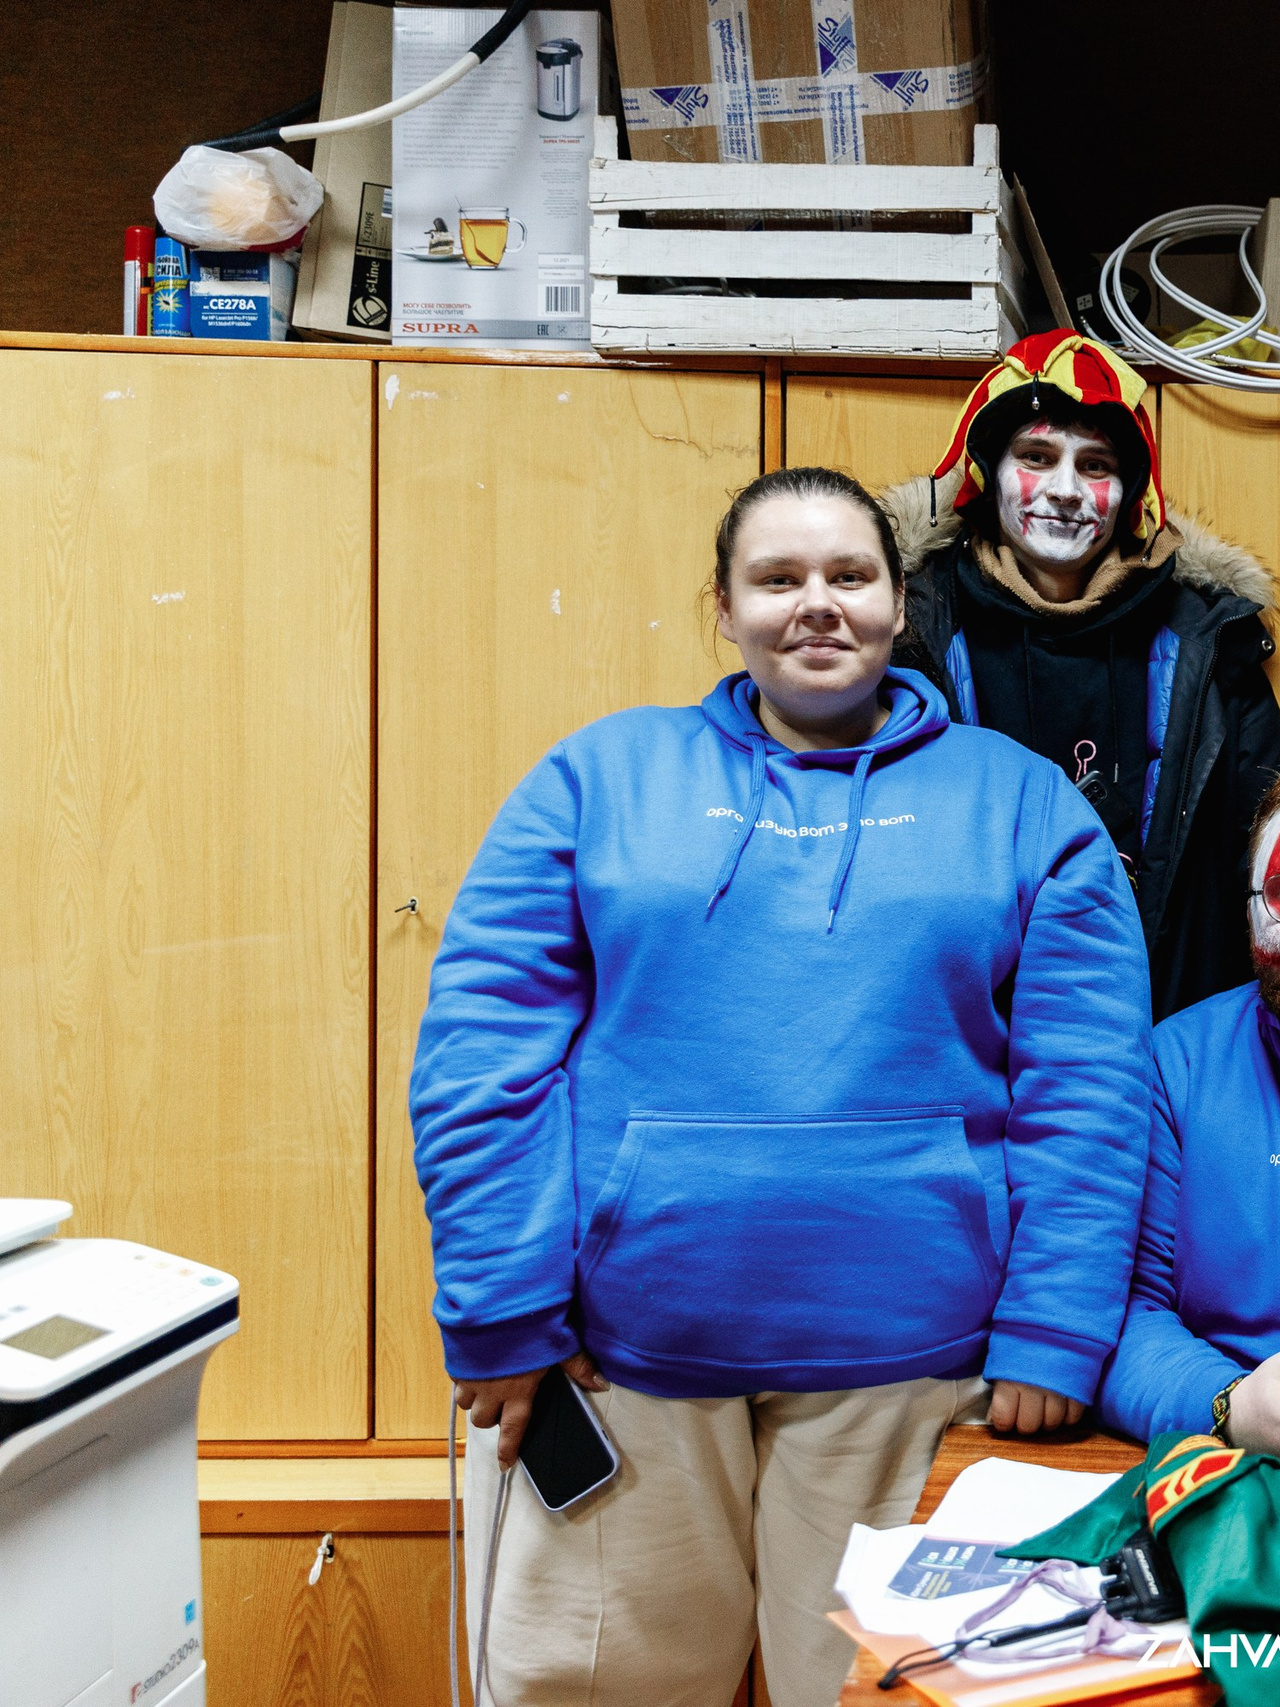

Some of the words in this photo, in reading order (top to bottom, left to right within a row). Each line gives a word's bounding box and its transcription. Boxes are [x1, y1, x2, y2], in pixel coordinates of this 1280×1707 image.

[818, 17, 851, 57] Stuff
[674, 86, 709, 121] Stuff
[894, 71, 929, 107] Stuff
[156, 264, 182, 277] СИЛА
[367, 260, 381, 294] s-Line
[209, 298, 256, 311] CE278A
[402, 322, 479, 334] SUPRA
[706, 807, 797, 838] оргаизую
[799, 823, 835, 837] вот
[837, 819, 876, 832] эо
[878, 813, 915, 827] вот
